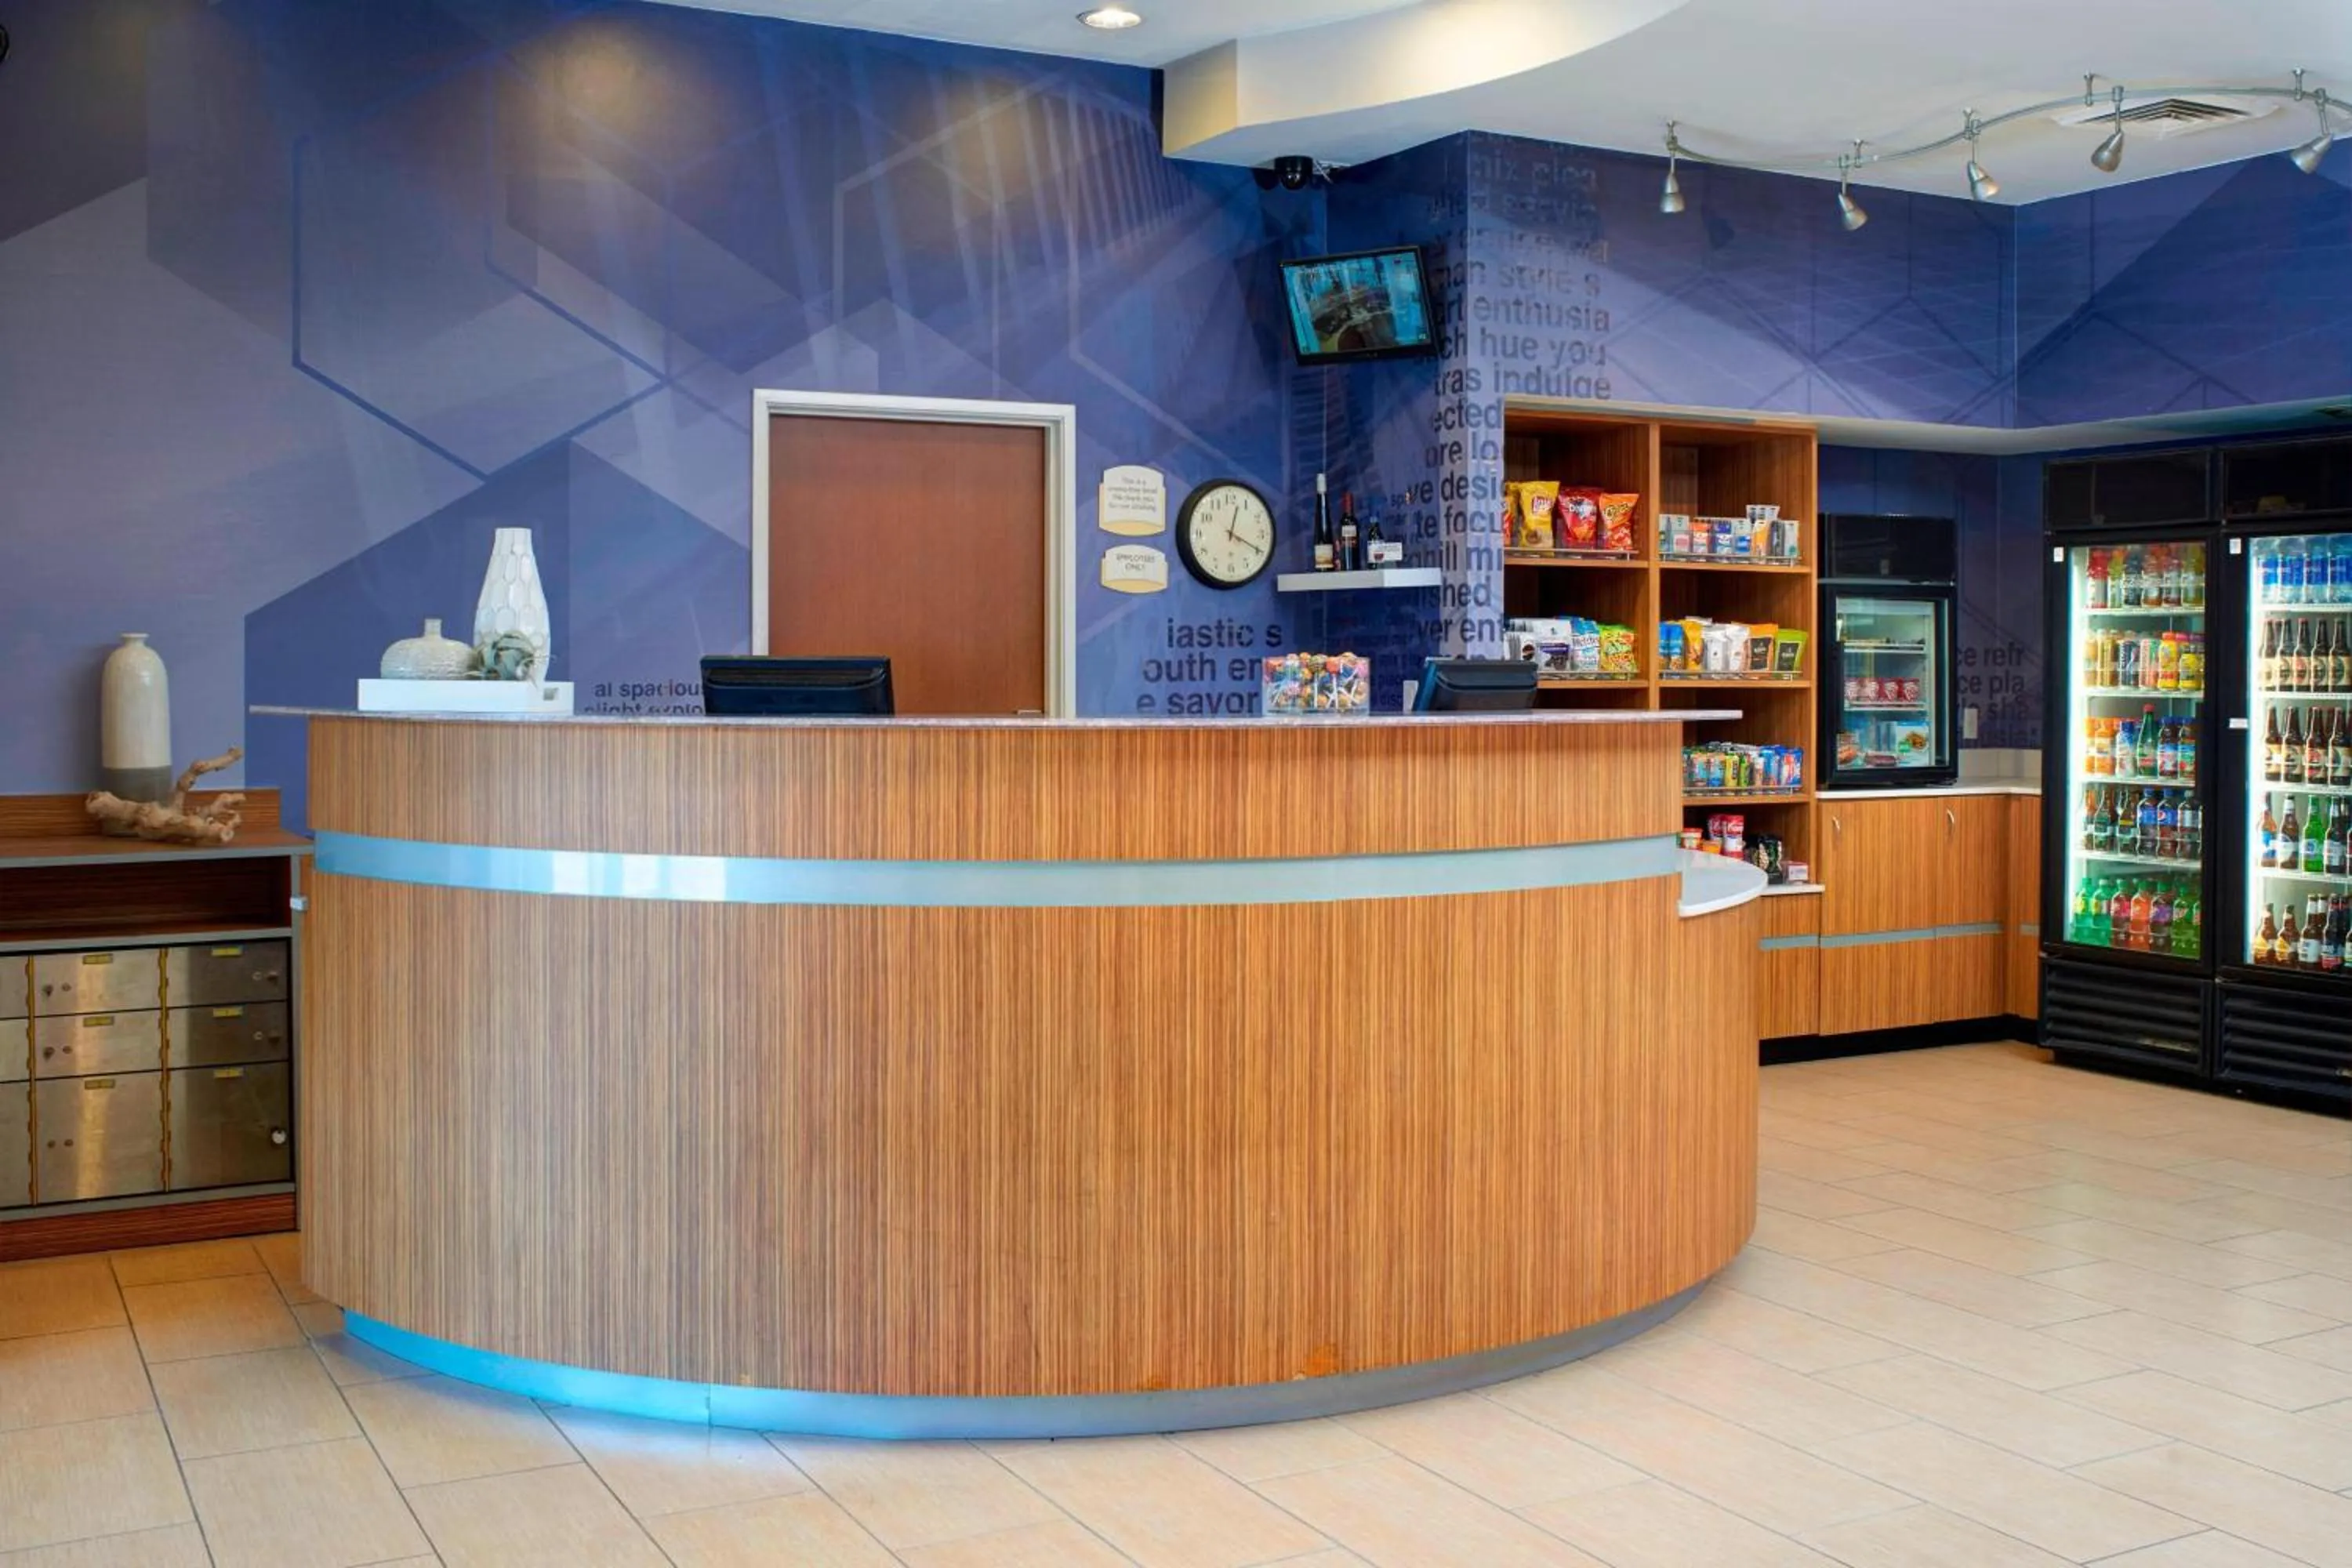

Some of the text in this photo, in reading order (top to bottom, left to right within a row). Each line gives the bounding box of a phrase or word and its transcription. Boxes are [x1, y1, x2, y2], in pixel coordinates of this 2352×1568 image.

[1473, 294, 1610, 333] enthusia
[1480, 327, 1539, 359] hue
[1548, 338, 1606, 369] you
[1494, 362, 1612, 399] indulge
[1441, 468, 1504, 502] desi
[1167, 618, 1283, 648] iastic s
[619, 679, 704, 701] spaciou
[1990, 669, 2024, 700] pla
[1167, 690, 1259, 715] savor
